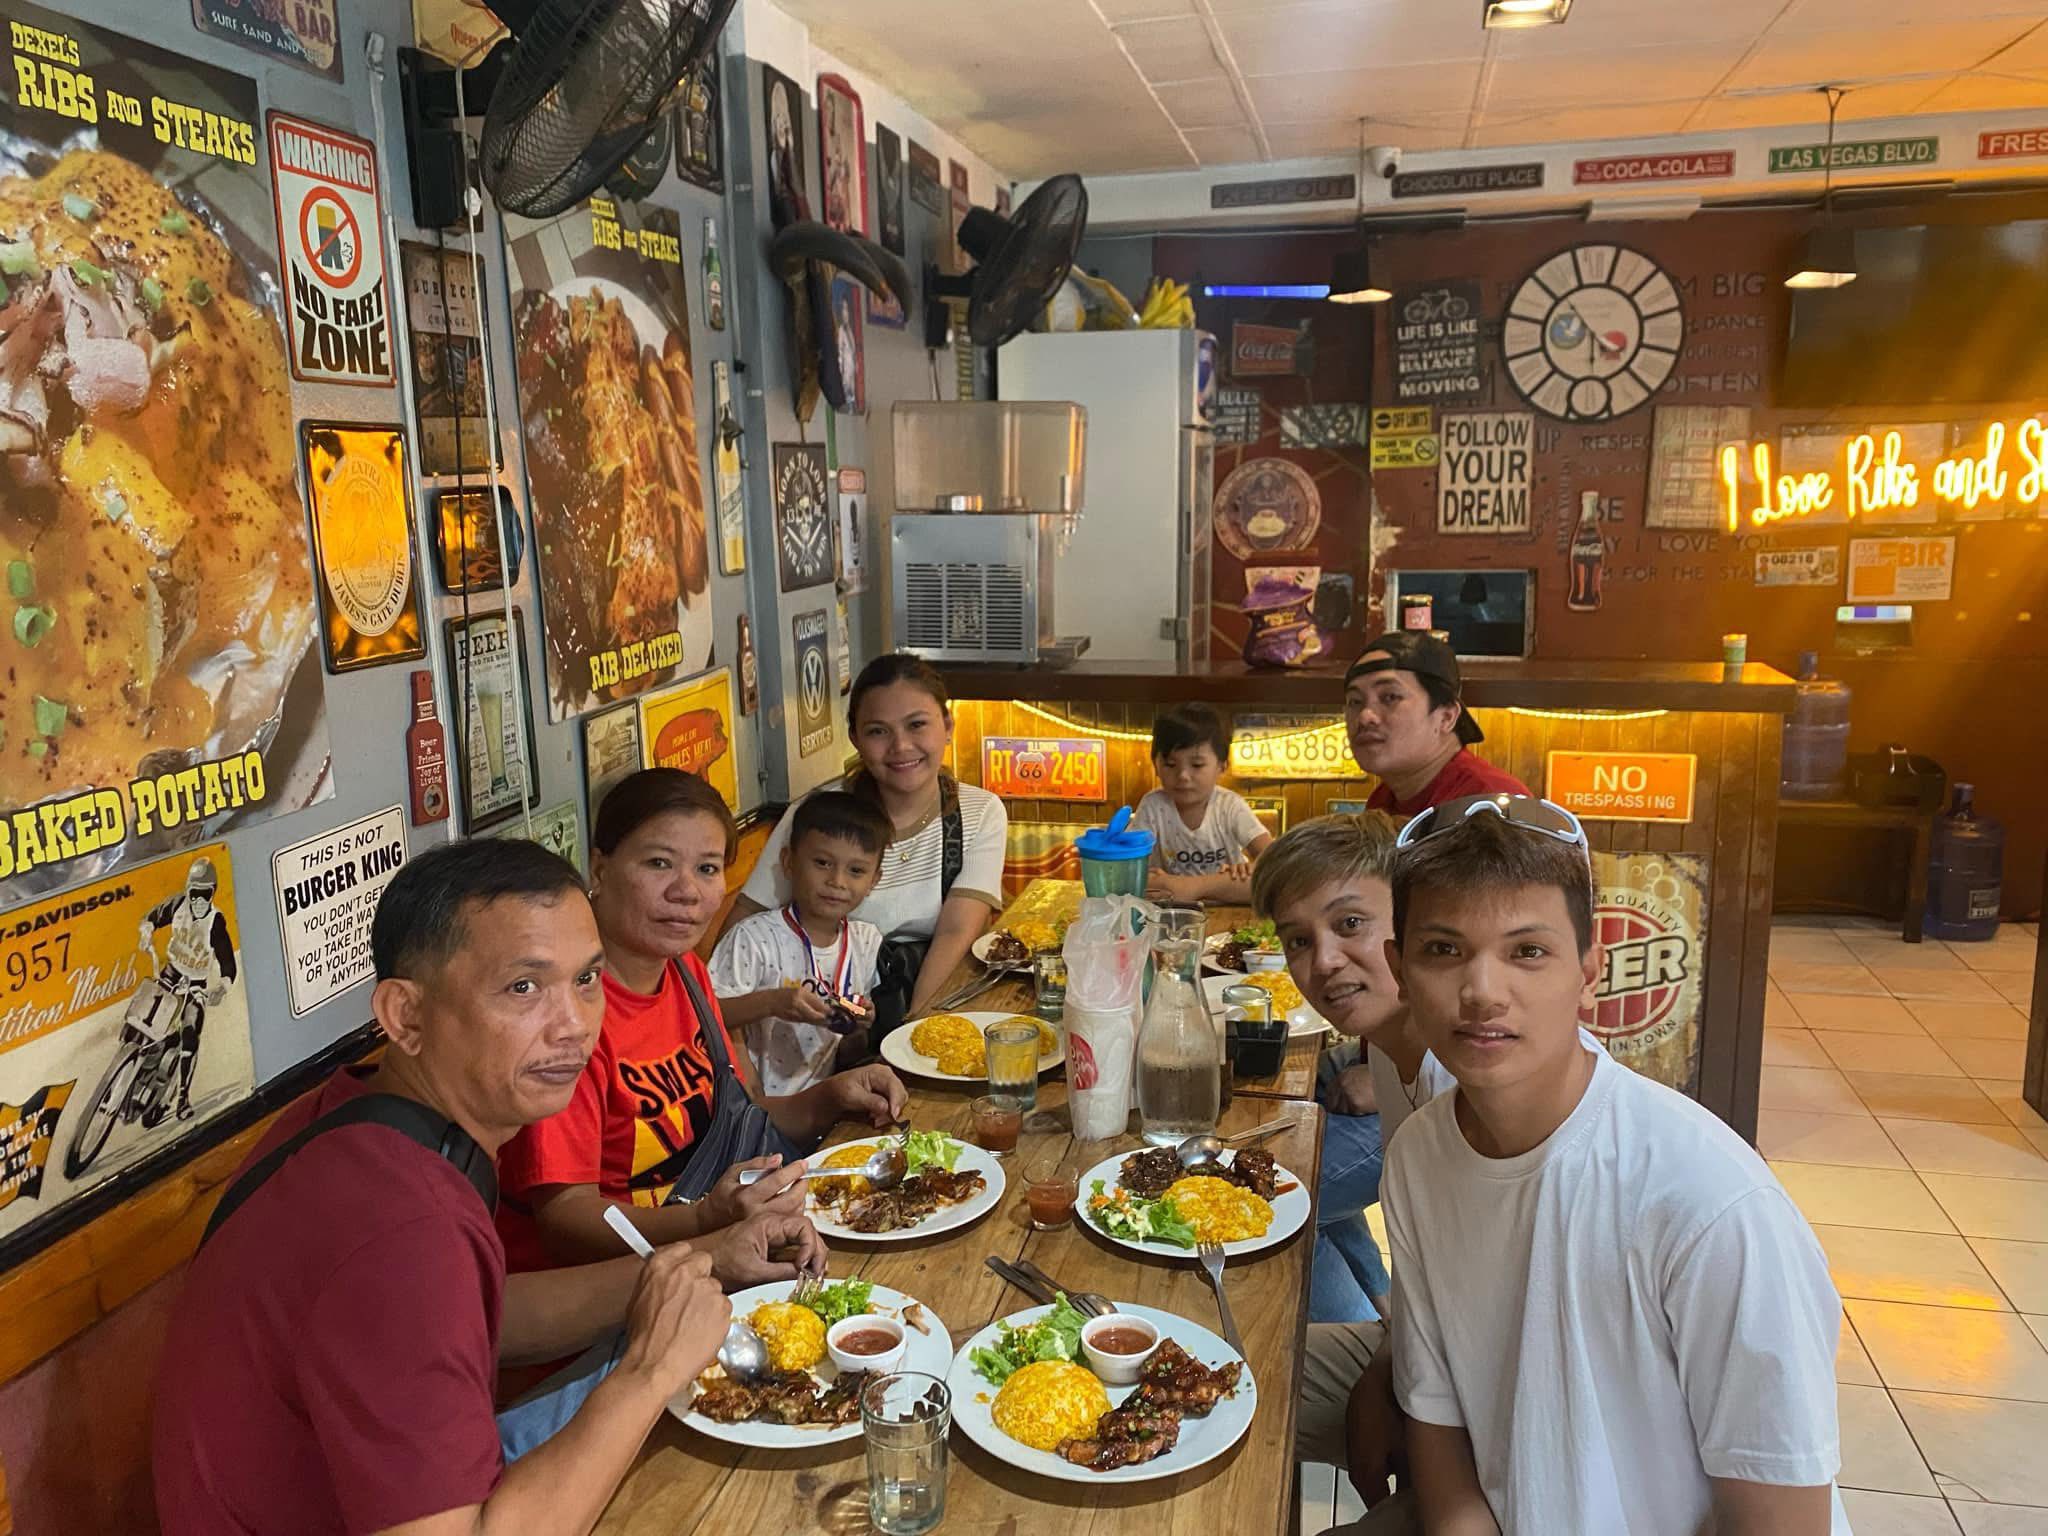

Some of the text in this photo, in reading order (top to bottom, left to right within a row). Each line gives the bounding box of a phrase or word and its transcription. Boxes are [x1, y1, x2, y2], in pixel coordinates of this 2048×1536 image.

[10, 21, 80, 67] DEXEL'S
[211, 10, 237, 31] SURF
[242, 23, 272, 44] SAND
[276, 37, 299, 54] AND
[14, 55, 256, 165] RIBS AND STEAKS
[277, 129, 371, 189] WARNING
[1602, 157, 1705, 179] COCA-COLA
[1777, 141, 1934, 169] LAS VEGAS BLVD.
[1399, 168, 1537, 193] CHOCOLATE PLACE
[592, 218, 622, 251] RIBS
[639, 229, 680, 265] STEAKS
[292, 258, 384, 331] NO FART
[413, 280, 476, 300] SUBECT
[298, 308, 390, 376] ZONE
[1398, 319, 1478, 340] LIFE IS LIKE
[1400, 376, 1480, 397] MOVING
[1445, 419, 1529, 447] FOLLOW
[1580, 433, 1650, 451] RESPEC
[1445, 450, 1527, 484] YOUR
[1751, 443, 1834, 526] Love
[1846, 430, 1920, 520] Ribs
[1933, 421, 2008, 509] and
[1444, 488, 1526, 527] DREAM
[1659, 535, 1719, 552] LOVE
[1900, 542, 1946, 567] BIR
[370, 601, 394, 627] GATE
[590, 632, 684, 691] RIB DELUXED
[420, 765, 440, 778] Joy of
[990, 750, 1099, 785] RT 66 2450
[1593, 765, 1647, 792] NO
[0, 751, 265, 879] BAKED POTATO
[301, 825, 384, 872] THIS IS NOT
[283, 840, 403, 917] BURGER KING
[303, 885, 385, 934] YOU DON'T GET
[323, 916, 353, 941] YOUR
[1615, 894, 1683, 932] QUALITY
[0, 932, 71, 998] 957
[298, 949, 321, 970] YOU
[324, 934, 351, 954] TAKE
[354, 926, 364, 943] IT
[306, 941, 374, 984] OR YOU DON
[66, 953, 137, 1015] Models
[330, 954, 375, 989] ANYTHIN
[1613, 1019, 1677, 1052] IN TOWN
